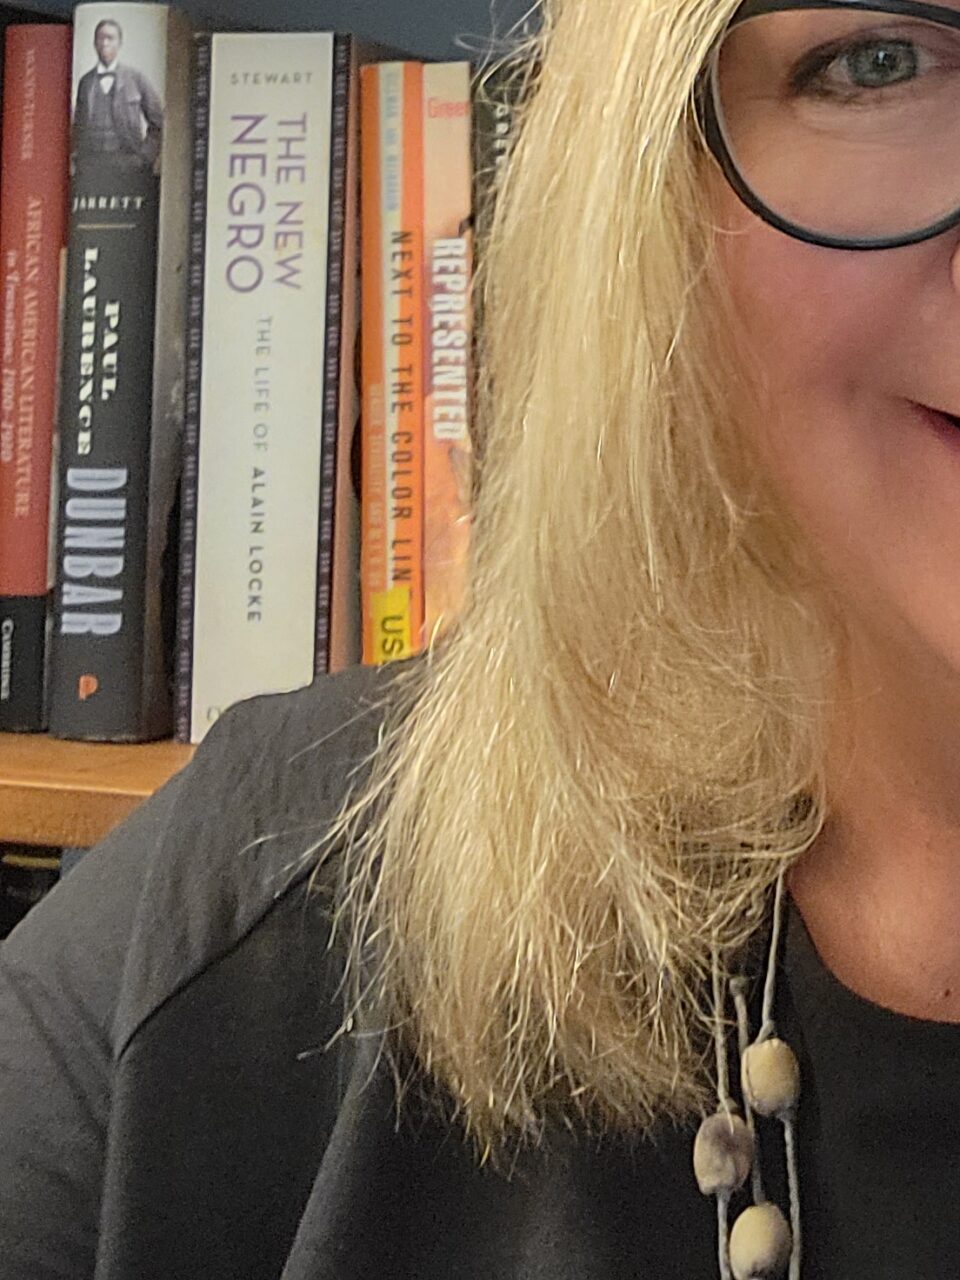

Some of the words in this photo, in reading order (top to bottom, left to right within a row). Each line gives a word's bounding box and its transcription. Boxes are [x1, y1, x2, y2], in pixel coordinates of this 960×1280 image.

[230, 71, 314, 86] STEWART
[275, 112, 307, 185] THE
[25, 197, 42, 282] AFRICAN
[226, 113, 268, 294] NEGRO
[274, 200, 304, 290] NEW
[390, 229, 414, 298] NEXT
[21, 286, 40, 392] AMERICAN
[77, 247, 99, 455] LAURENCE
[101, 300, 120, 401] PAUL
[255, 315, 273, 357] THE
[390, 315, 414, 346] TO
[430, 238, 468, 441] REPRESENTED
[253, 366, 271, 413] LIFE
[390, 364, 414, 413] THE
[14, 394, 36, 519] LITERATURE
[252, 423, 269, 454] OF
[390, 431, 414, 520] COLOR
[249, 466, 266, 534] ALAIN
[60, 467, 128, 636] DUNBAR
[246, 545, 265, 625] LOCKE
[391, 539, 413, 593] LIN
